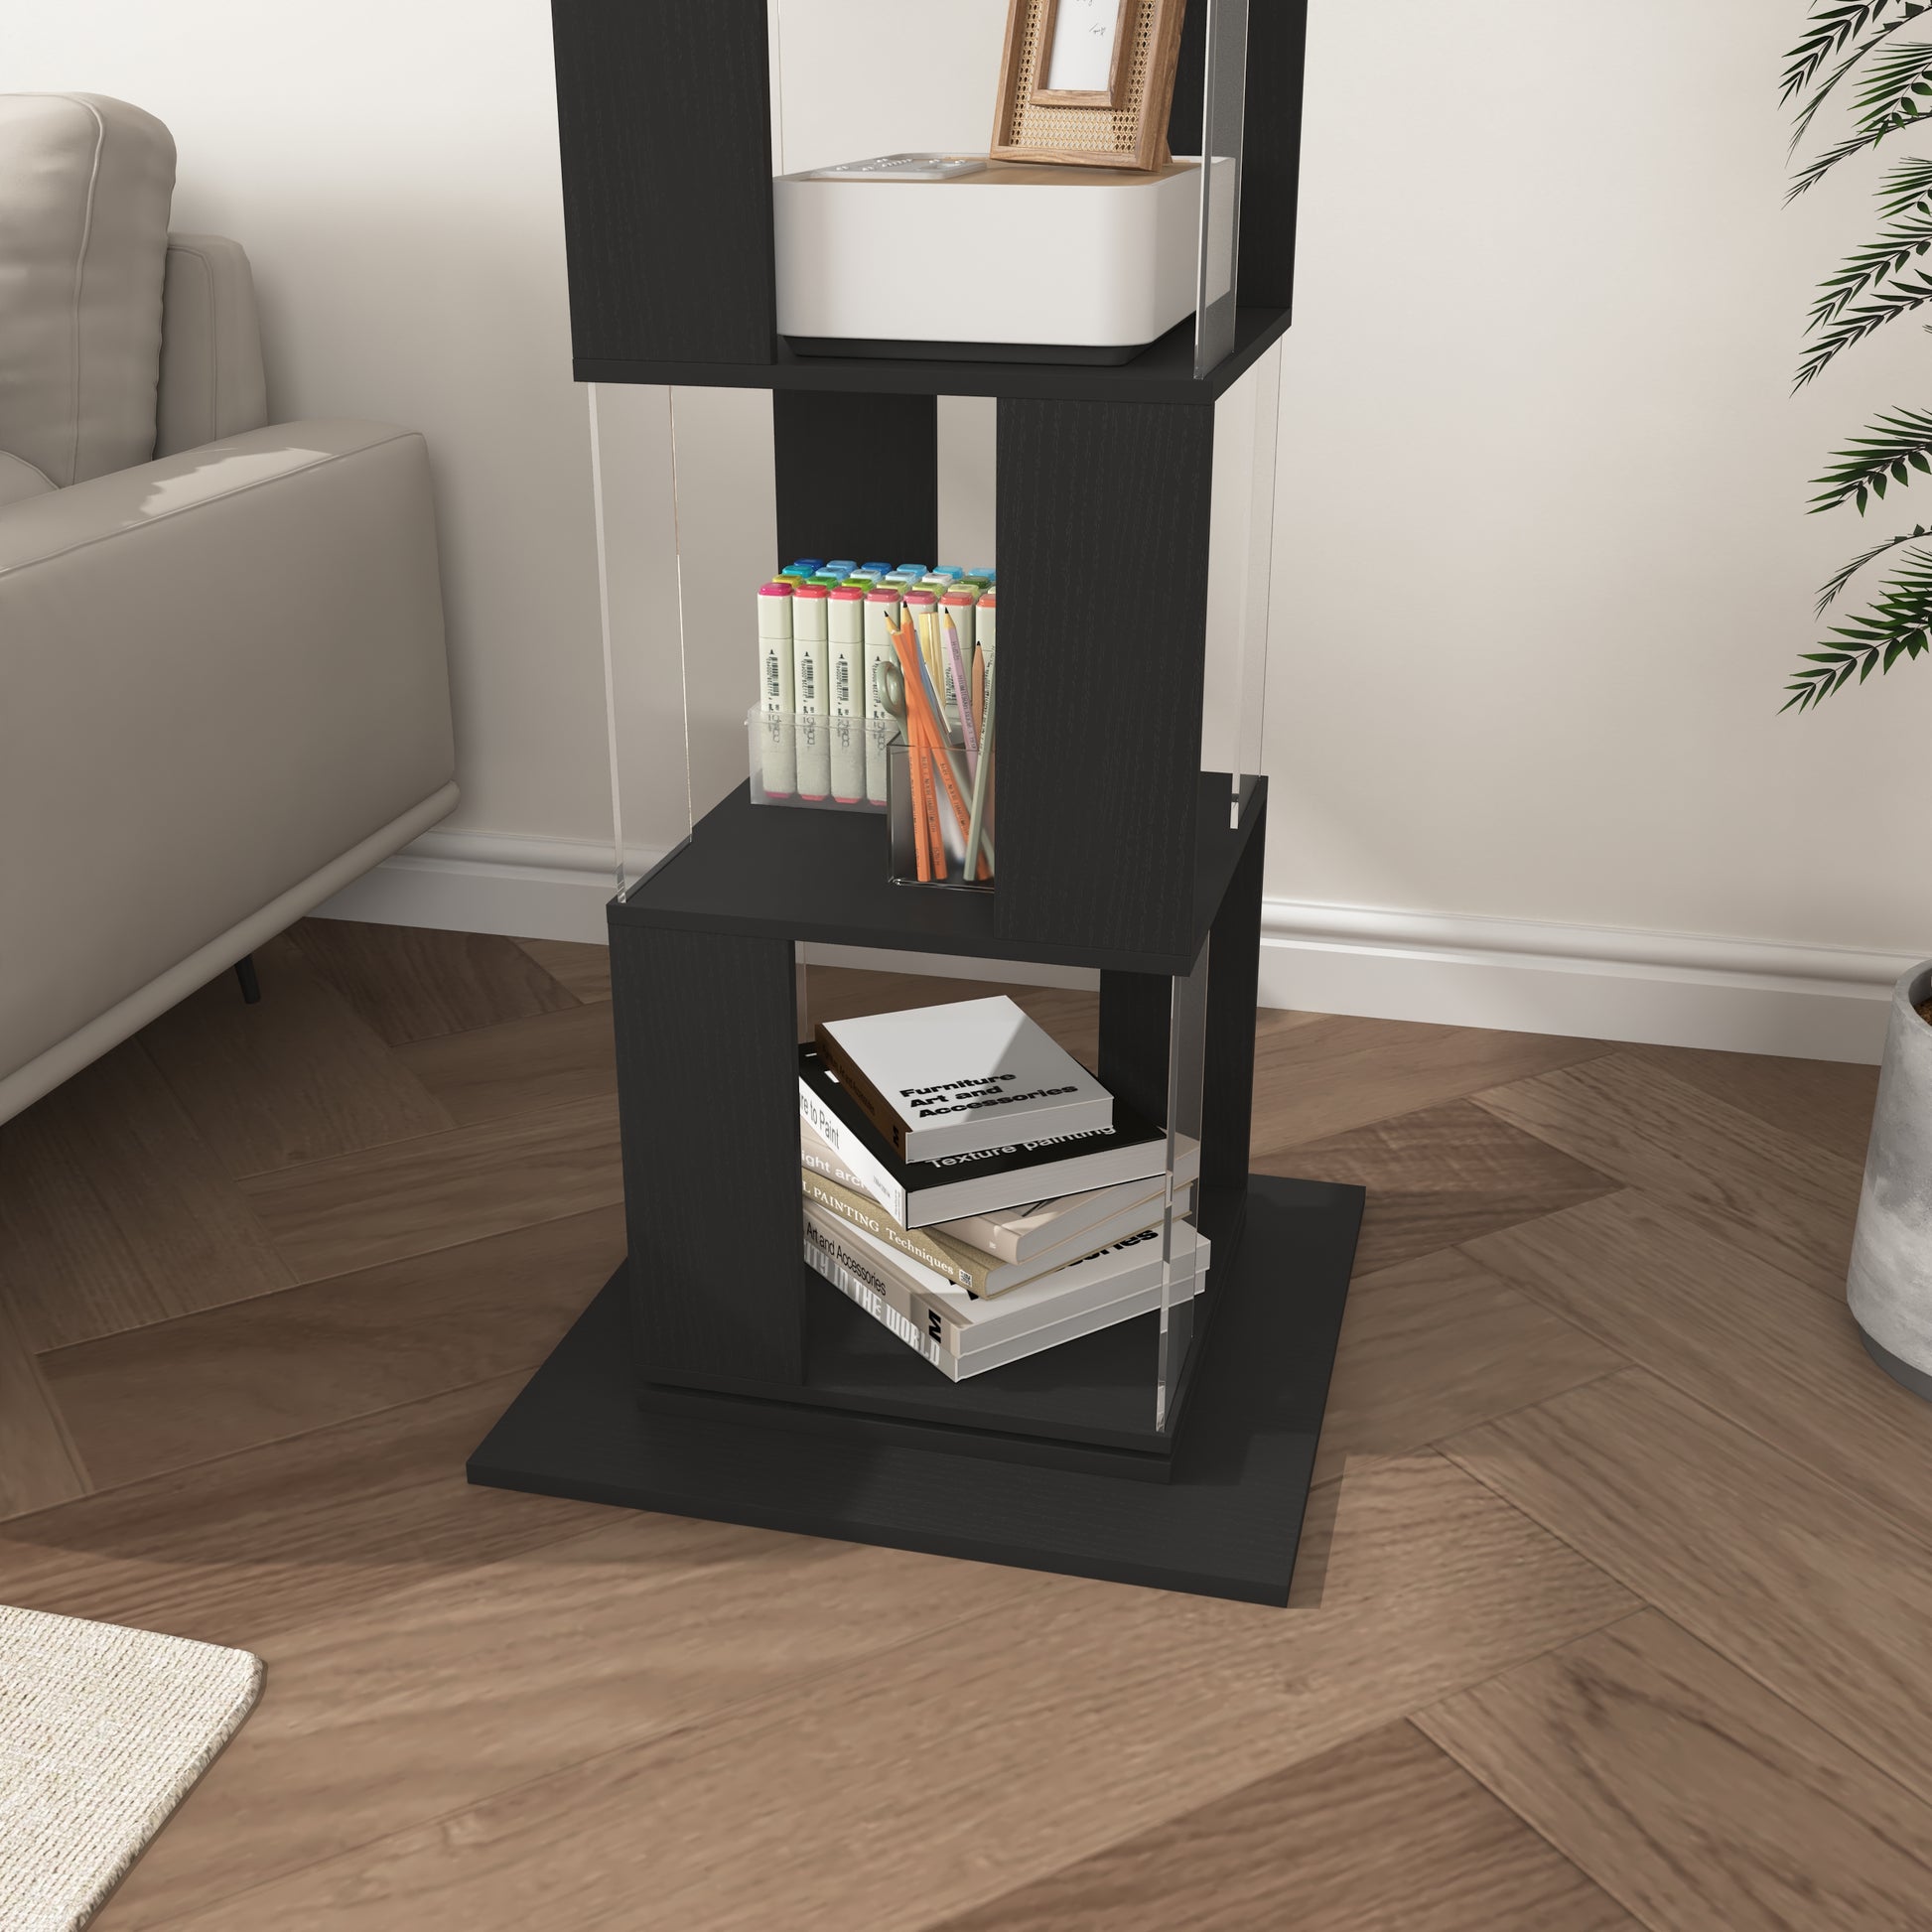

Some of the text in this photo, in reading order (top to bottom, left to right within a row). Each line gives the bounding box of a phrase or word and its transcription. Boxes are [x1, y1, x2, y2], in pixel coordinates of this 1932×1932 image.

[899, 1073, 1017, 1098] Furniture
[910, 1085, 1003, 1108] Art and
[918, 1085, 1078, 1118] Accessories
[810, 1100, 818, 1125] to
[819, 1110, 840, 1150] Paint
[924, 1126, 1117, 1169] Texture painting
[813, 1187, 881, 1233] PAINTING
[886, 1228, 955, 1276] Techniques
[806, 1221, 887, 1297] Art and Accessories
[803, 1239, 830, 1277] ITY
[853, 1278, 882, 1321] THE
[886, 1303, 941, 1366] WORLD
[928, 1309, 941, 1344] M
